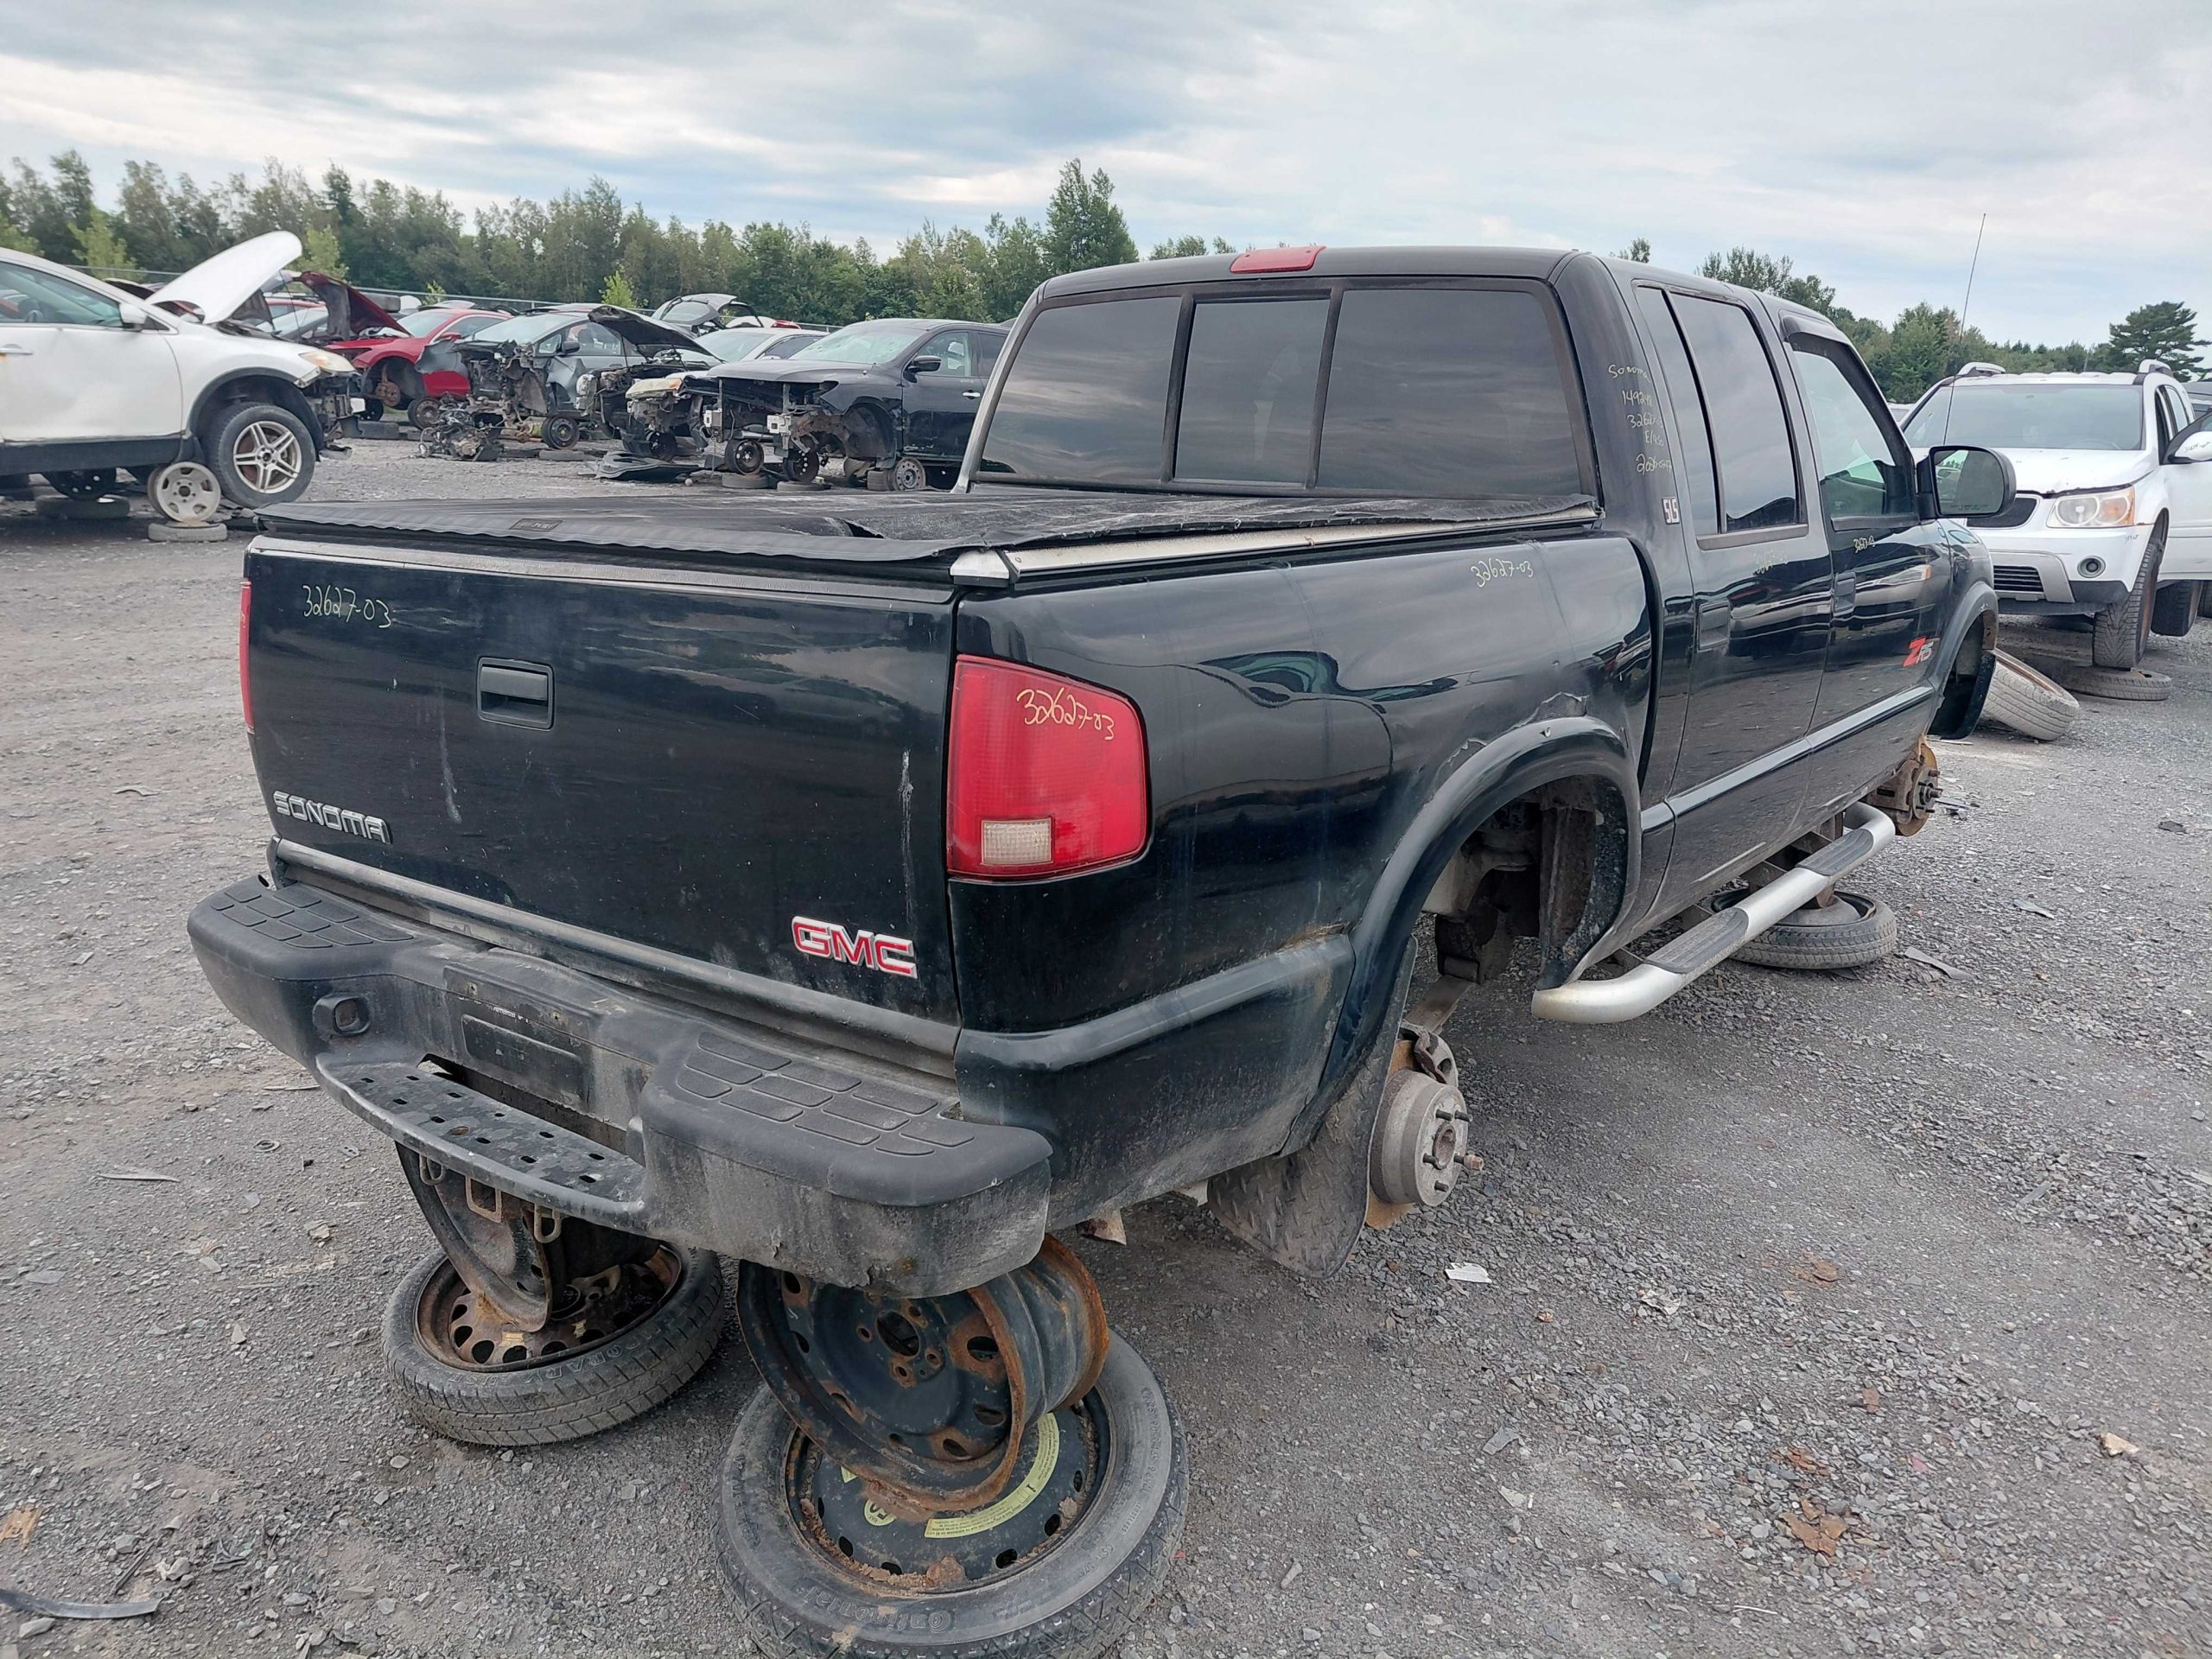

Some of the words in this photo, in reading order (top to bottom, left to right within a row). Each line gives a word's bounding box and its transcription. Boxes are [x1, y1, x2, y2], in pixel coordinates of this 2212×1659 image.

[302, 584, 391, 628] 32627-03
[272, 790, 393, 845] SONOMA
[791, 915, 918, 980] GMC
